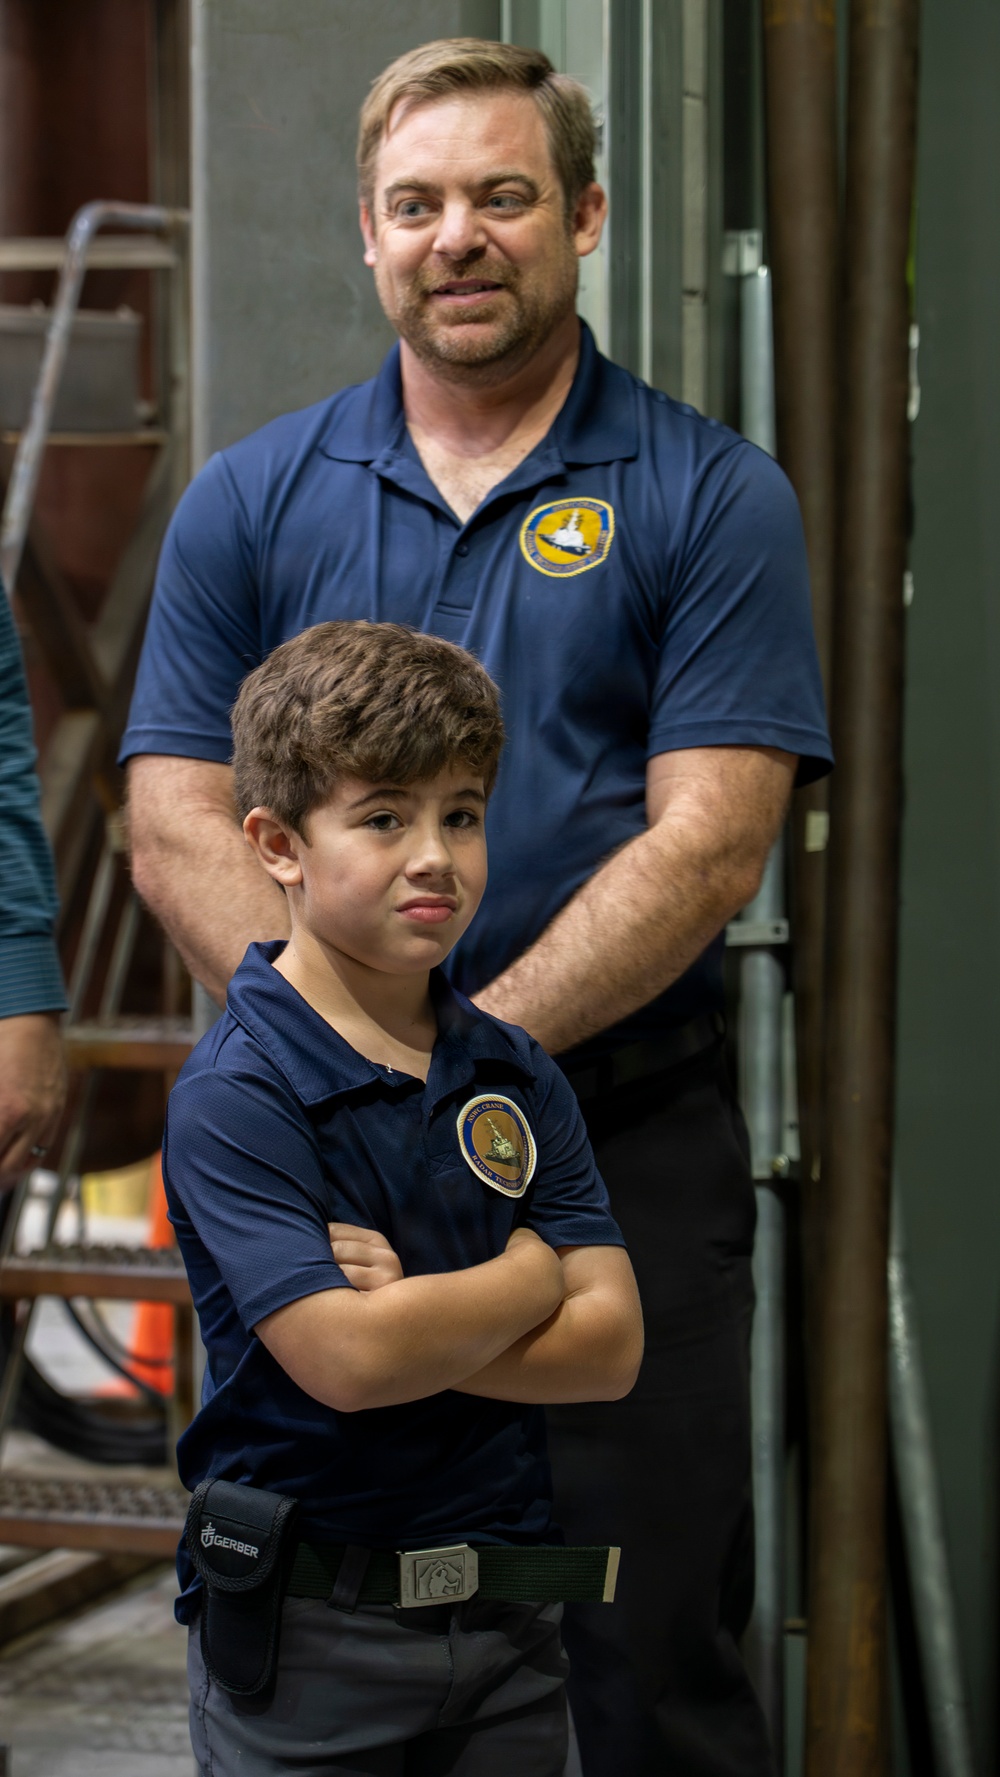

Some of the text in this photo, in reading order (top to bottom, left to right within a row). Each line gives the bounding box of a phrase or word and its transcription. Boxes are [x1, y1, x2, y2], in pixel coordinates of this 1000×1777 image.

[467, 1102, 504, 1124] NSWC CRANE
[471, 1154, 493, 1178] RADAR
[213, 1535, 259, 1559] GERBER
